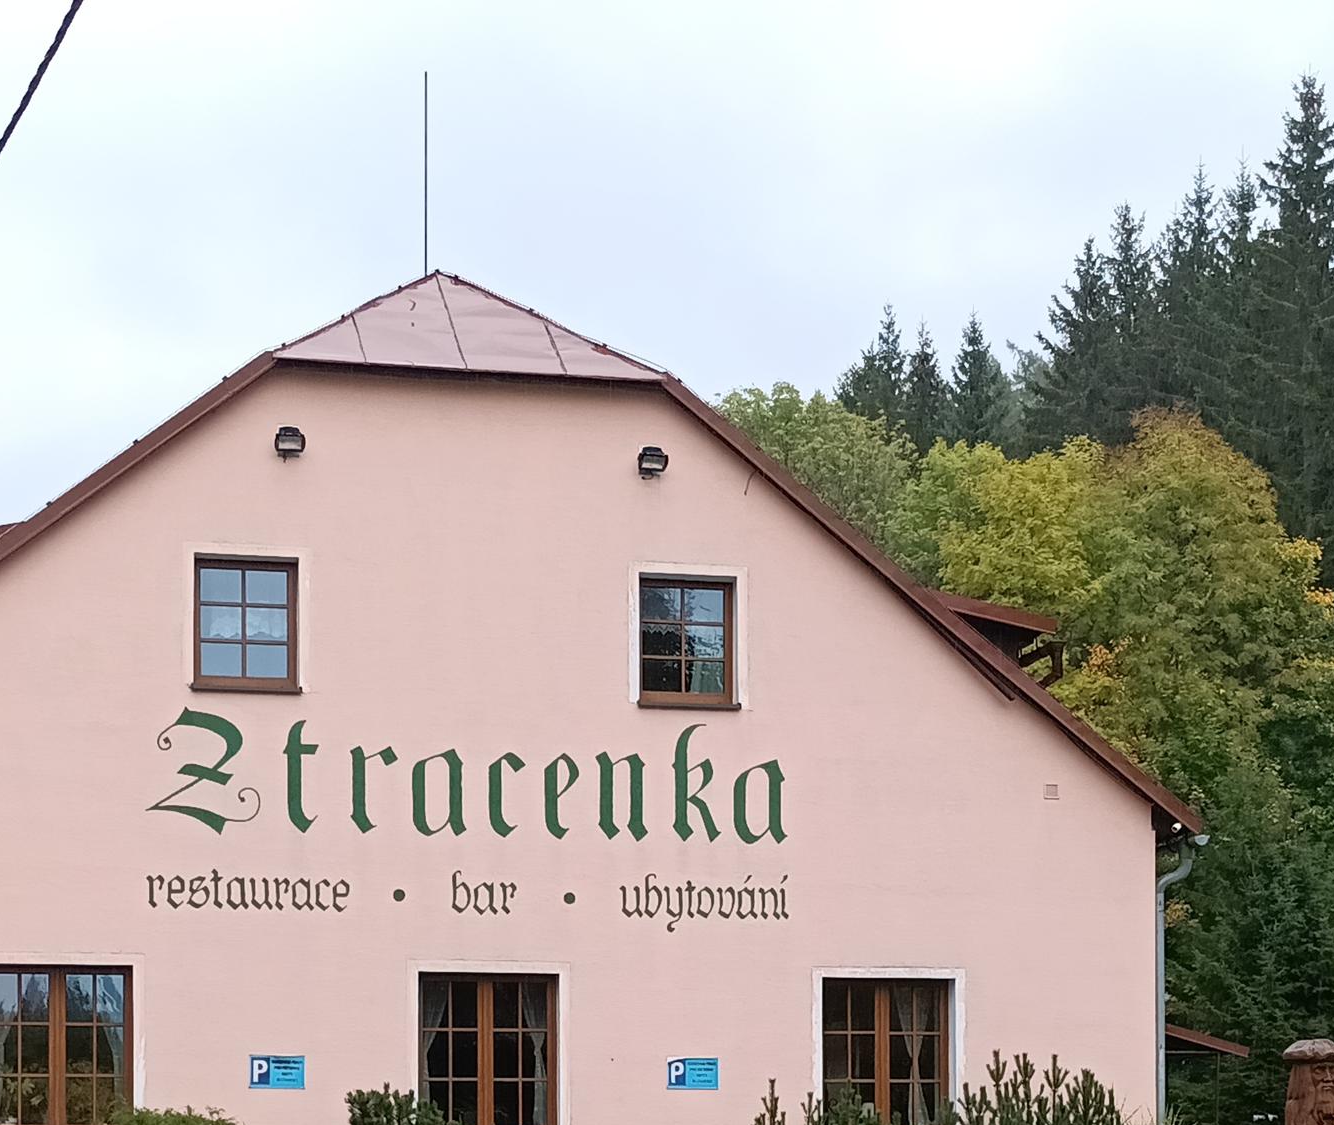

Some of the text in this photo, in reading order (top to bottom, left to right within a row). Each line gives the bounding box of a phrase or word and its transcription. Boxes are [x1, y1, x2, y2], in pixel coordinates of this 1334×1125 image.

[146, 706, 788, 845] Ztracenka
[146, 868, 790, 932] restaurace bar ubytování
[252, 1060, 269, 1083] P
[670, 1061, 685, 1084] P
